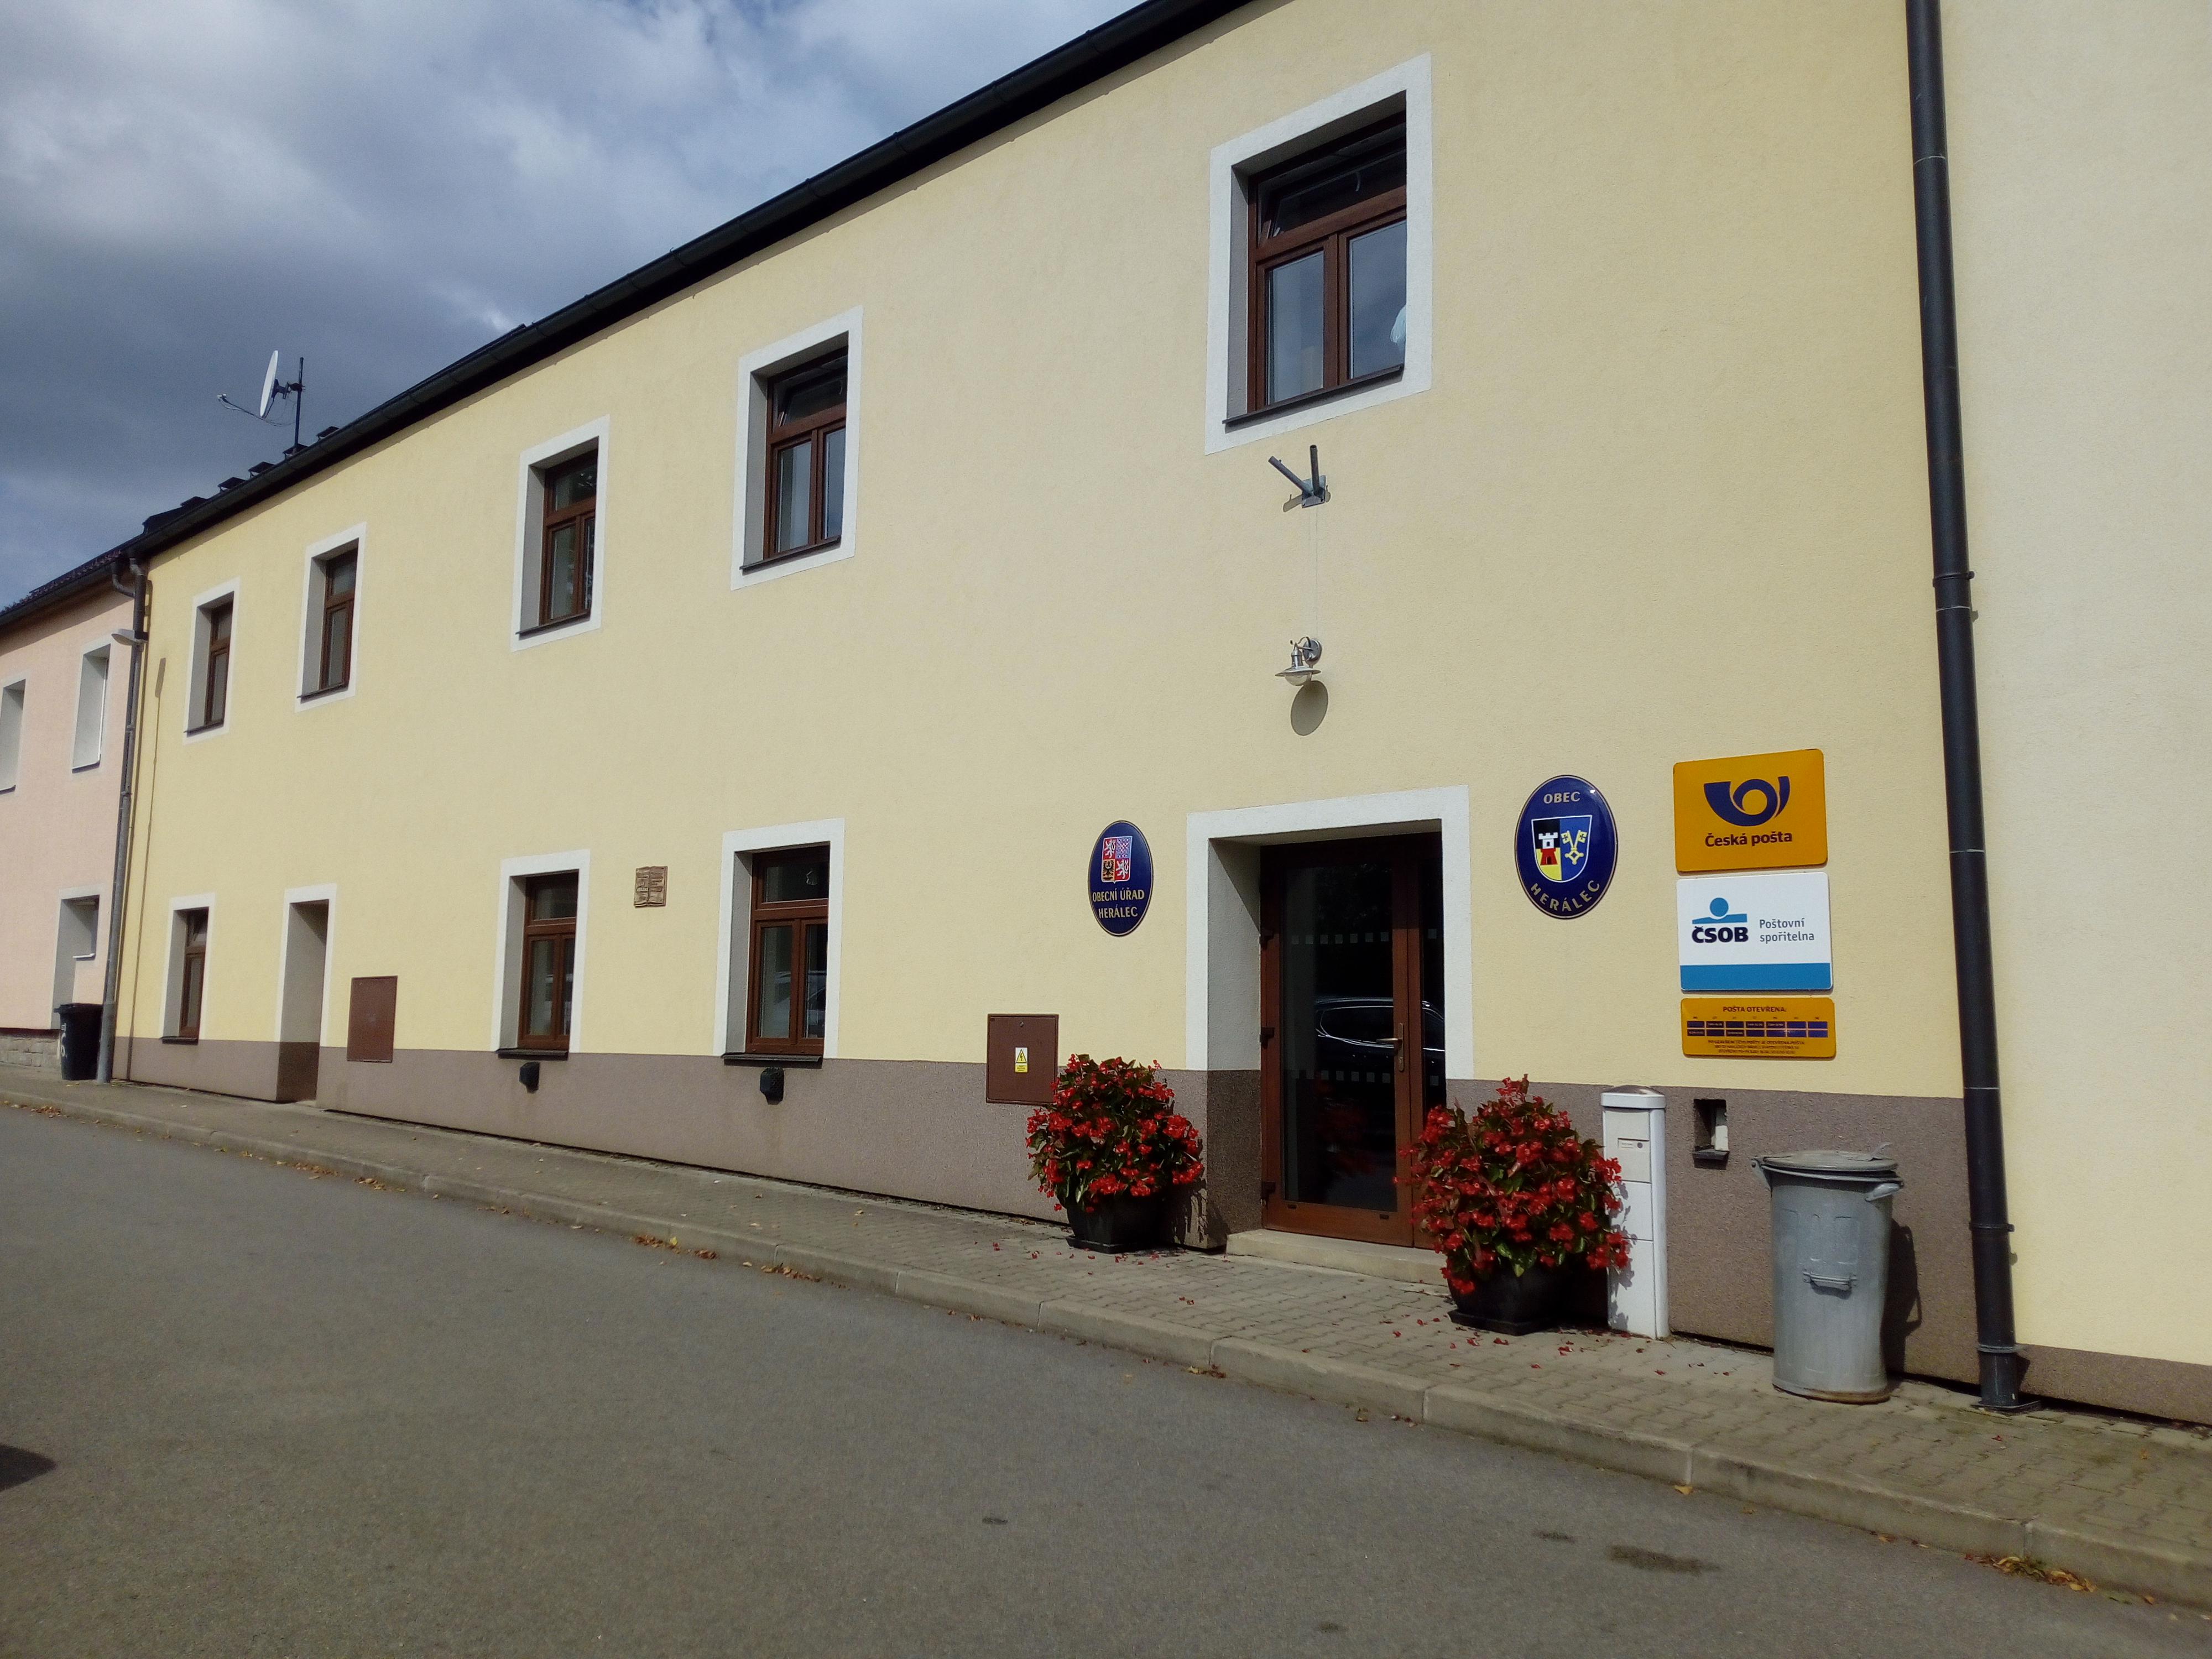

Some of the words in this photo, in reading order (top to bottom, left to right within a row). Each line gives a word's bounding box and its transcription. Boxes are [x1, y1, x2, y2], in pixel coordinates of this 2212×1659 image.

[1543, 791, 1580, 804] OBEC
[1705, 832, 1747, 847] Česká
[1751, 831, 1792, 846] pošta
[1092, 887, 1118, 902] OBECNÍ
[1120, 887, 1145, 901] ÚŘAD
[1530, 880, 1600, 911] HERÁLEC
[1098, 904, 1138, 919] HERÁLEC
[1759, 917, 1805, 928] Poštovní
[1692, 926, 1749, 943] ČSOB
[1760, 931, 1814, 944] spořitelna
